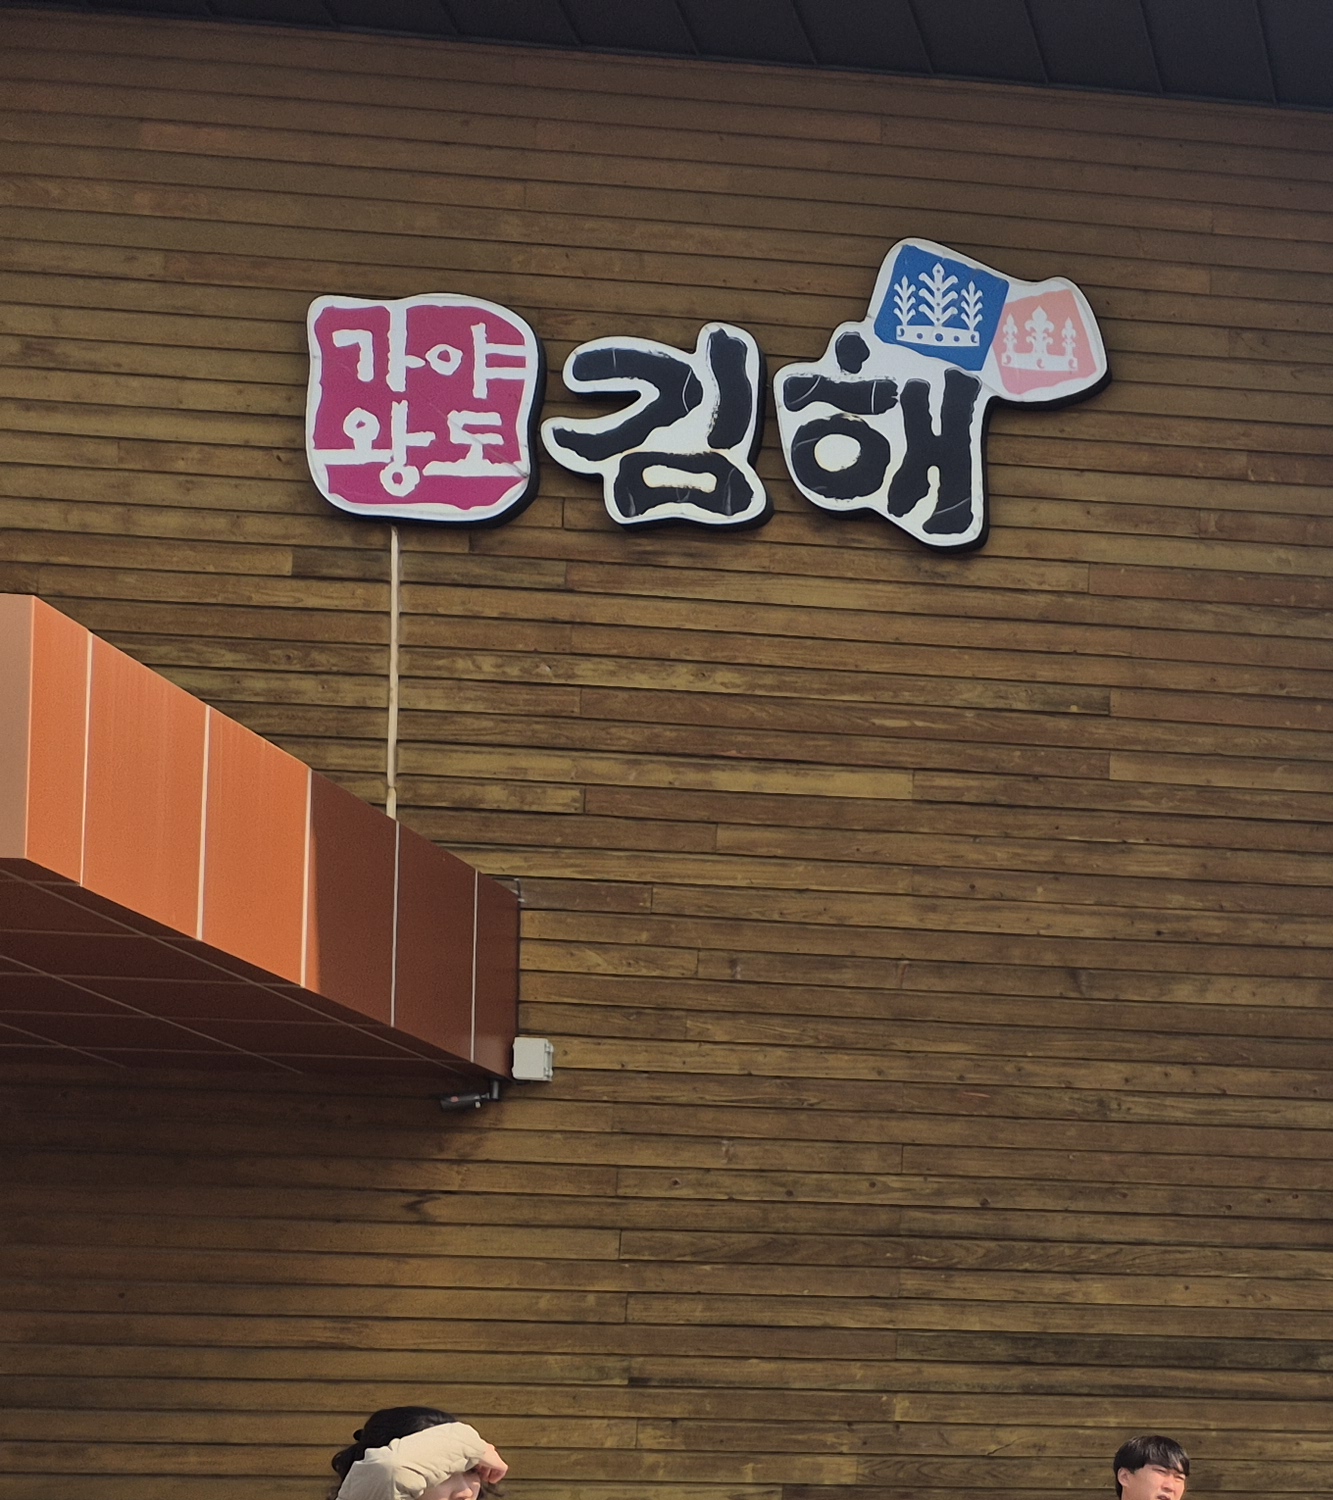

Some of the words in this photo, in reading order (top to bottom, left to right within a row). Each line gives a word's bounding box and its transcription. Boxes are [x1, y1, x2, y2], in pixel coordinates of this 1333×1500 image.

[332, 302, 528, 400] 가야
[313, 400, 529, 496] 왕도
[550, 325, 985, 535] 김해
